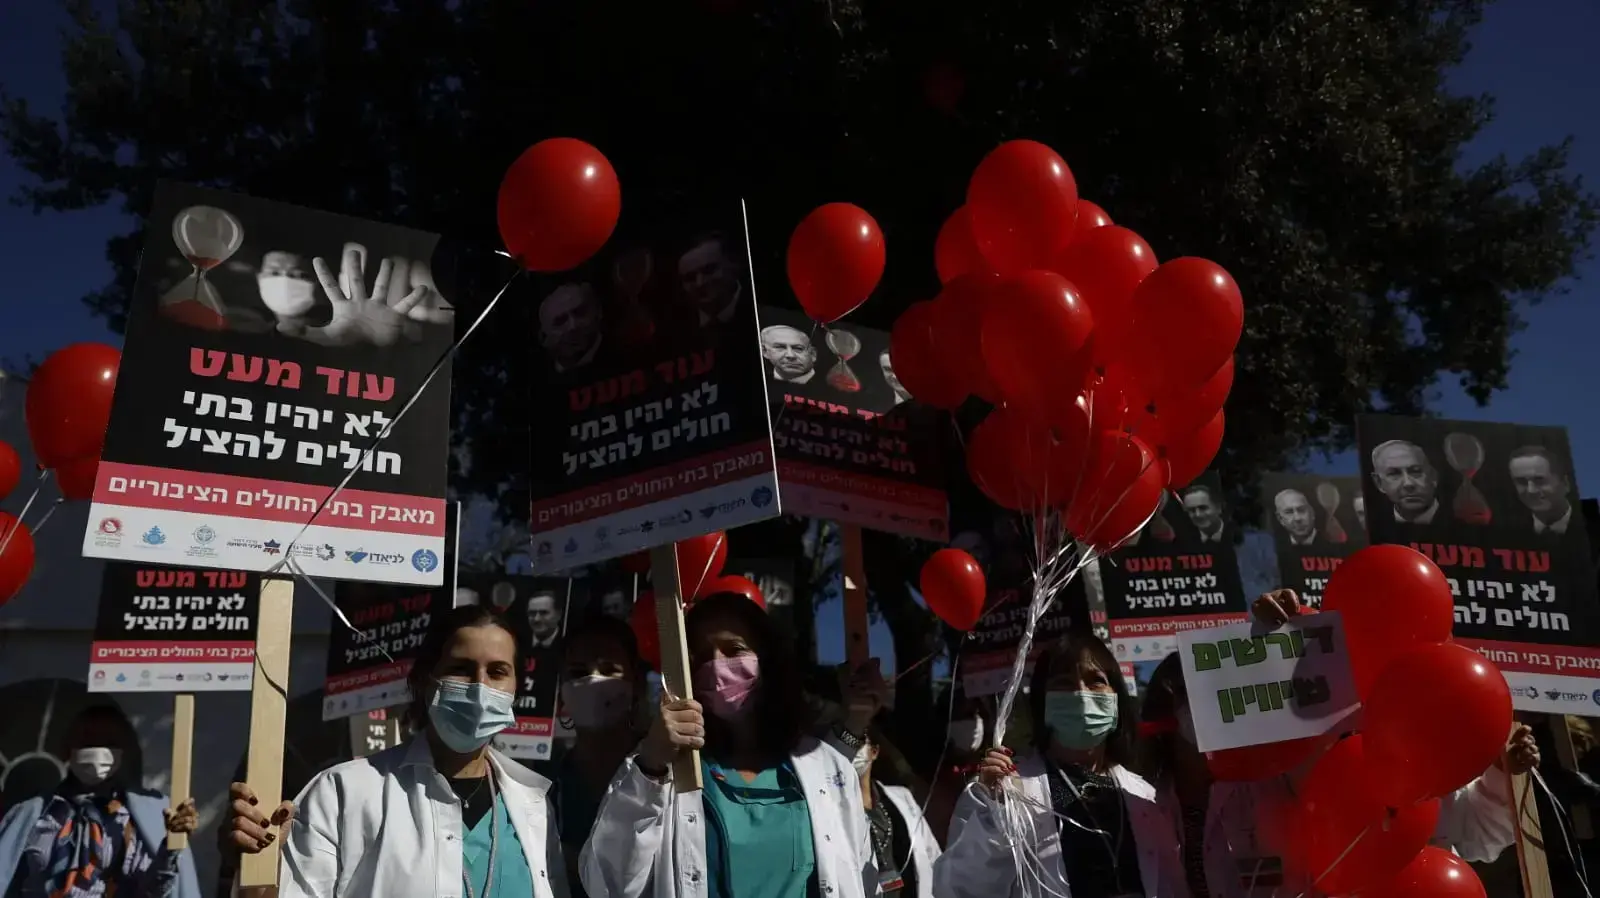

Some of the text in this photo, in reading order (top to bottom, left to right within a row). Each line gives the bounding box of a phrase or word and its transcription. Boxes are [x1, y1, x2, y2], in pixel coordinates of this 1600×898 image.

[188, 346, 396, 402] עוד מעט
[567, 349, 718, 412] עוד מעט
[182, 390, 394, 439] לא יהיו בתי
[569, 380, 719, 442] לא יהיו בתי
[783, 417, 824, 437] בתי
[830, 427, 871, 446] יהיו
[163, 416, 402, 475] חולים להציל
[561, 411, 732, 477] חולים להציל
[774, 431, 917, 475] חולים להציל
[678, 465, 709, 485] בתי
[712, 450, 765, 480] מאבק
[616, 475, 674, 502] החולים
[108, 476, 436, 525] מאבק בתי החולים הציבוריים
[538, 492, 612, 525] הציבוריים
[369, 552, 405, 564] לניאדו
[1124, 554, 1214, 573] עוד מעט
[1492, 548, 1552, 572] עוד
[136, 568, 248, 589] עוד מעט
[1128, 572, 1218, 592] לא יהיו בתי
[1466, 579, 1514, 600] יהיו
[132, 593, 246, 610] לא יהיו בתי
[1124, 589, 1226, 610] חולים להציל
[1520, 580, 1556, 602] לא
[123, 612, 249, 631] חולים להציל
[410, 612, 431, 630] לא
[1494, 605, 1571, 632] חולים
[98, 645, 255, 660] אבק בתי החולים הציבוריים
[1191, 626, 1334, 672] דורשים
[1523, 652, 1552, 666] בתי
